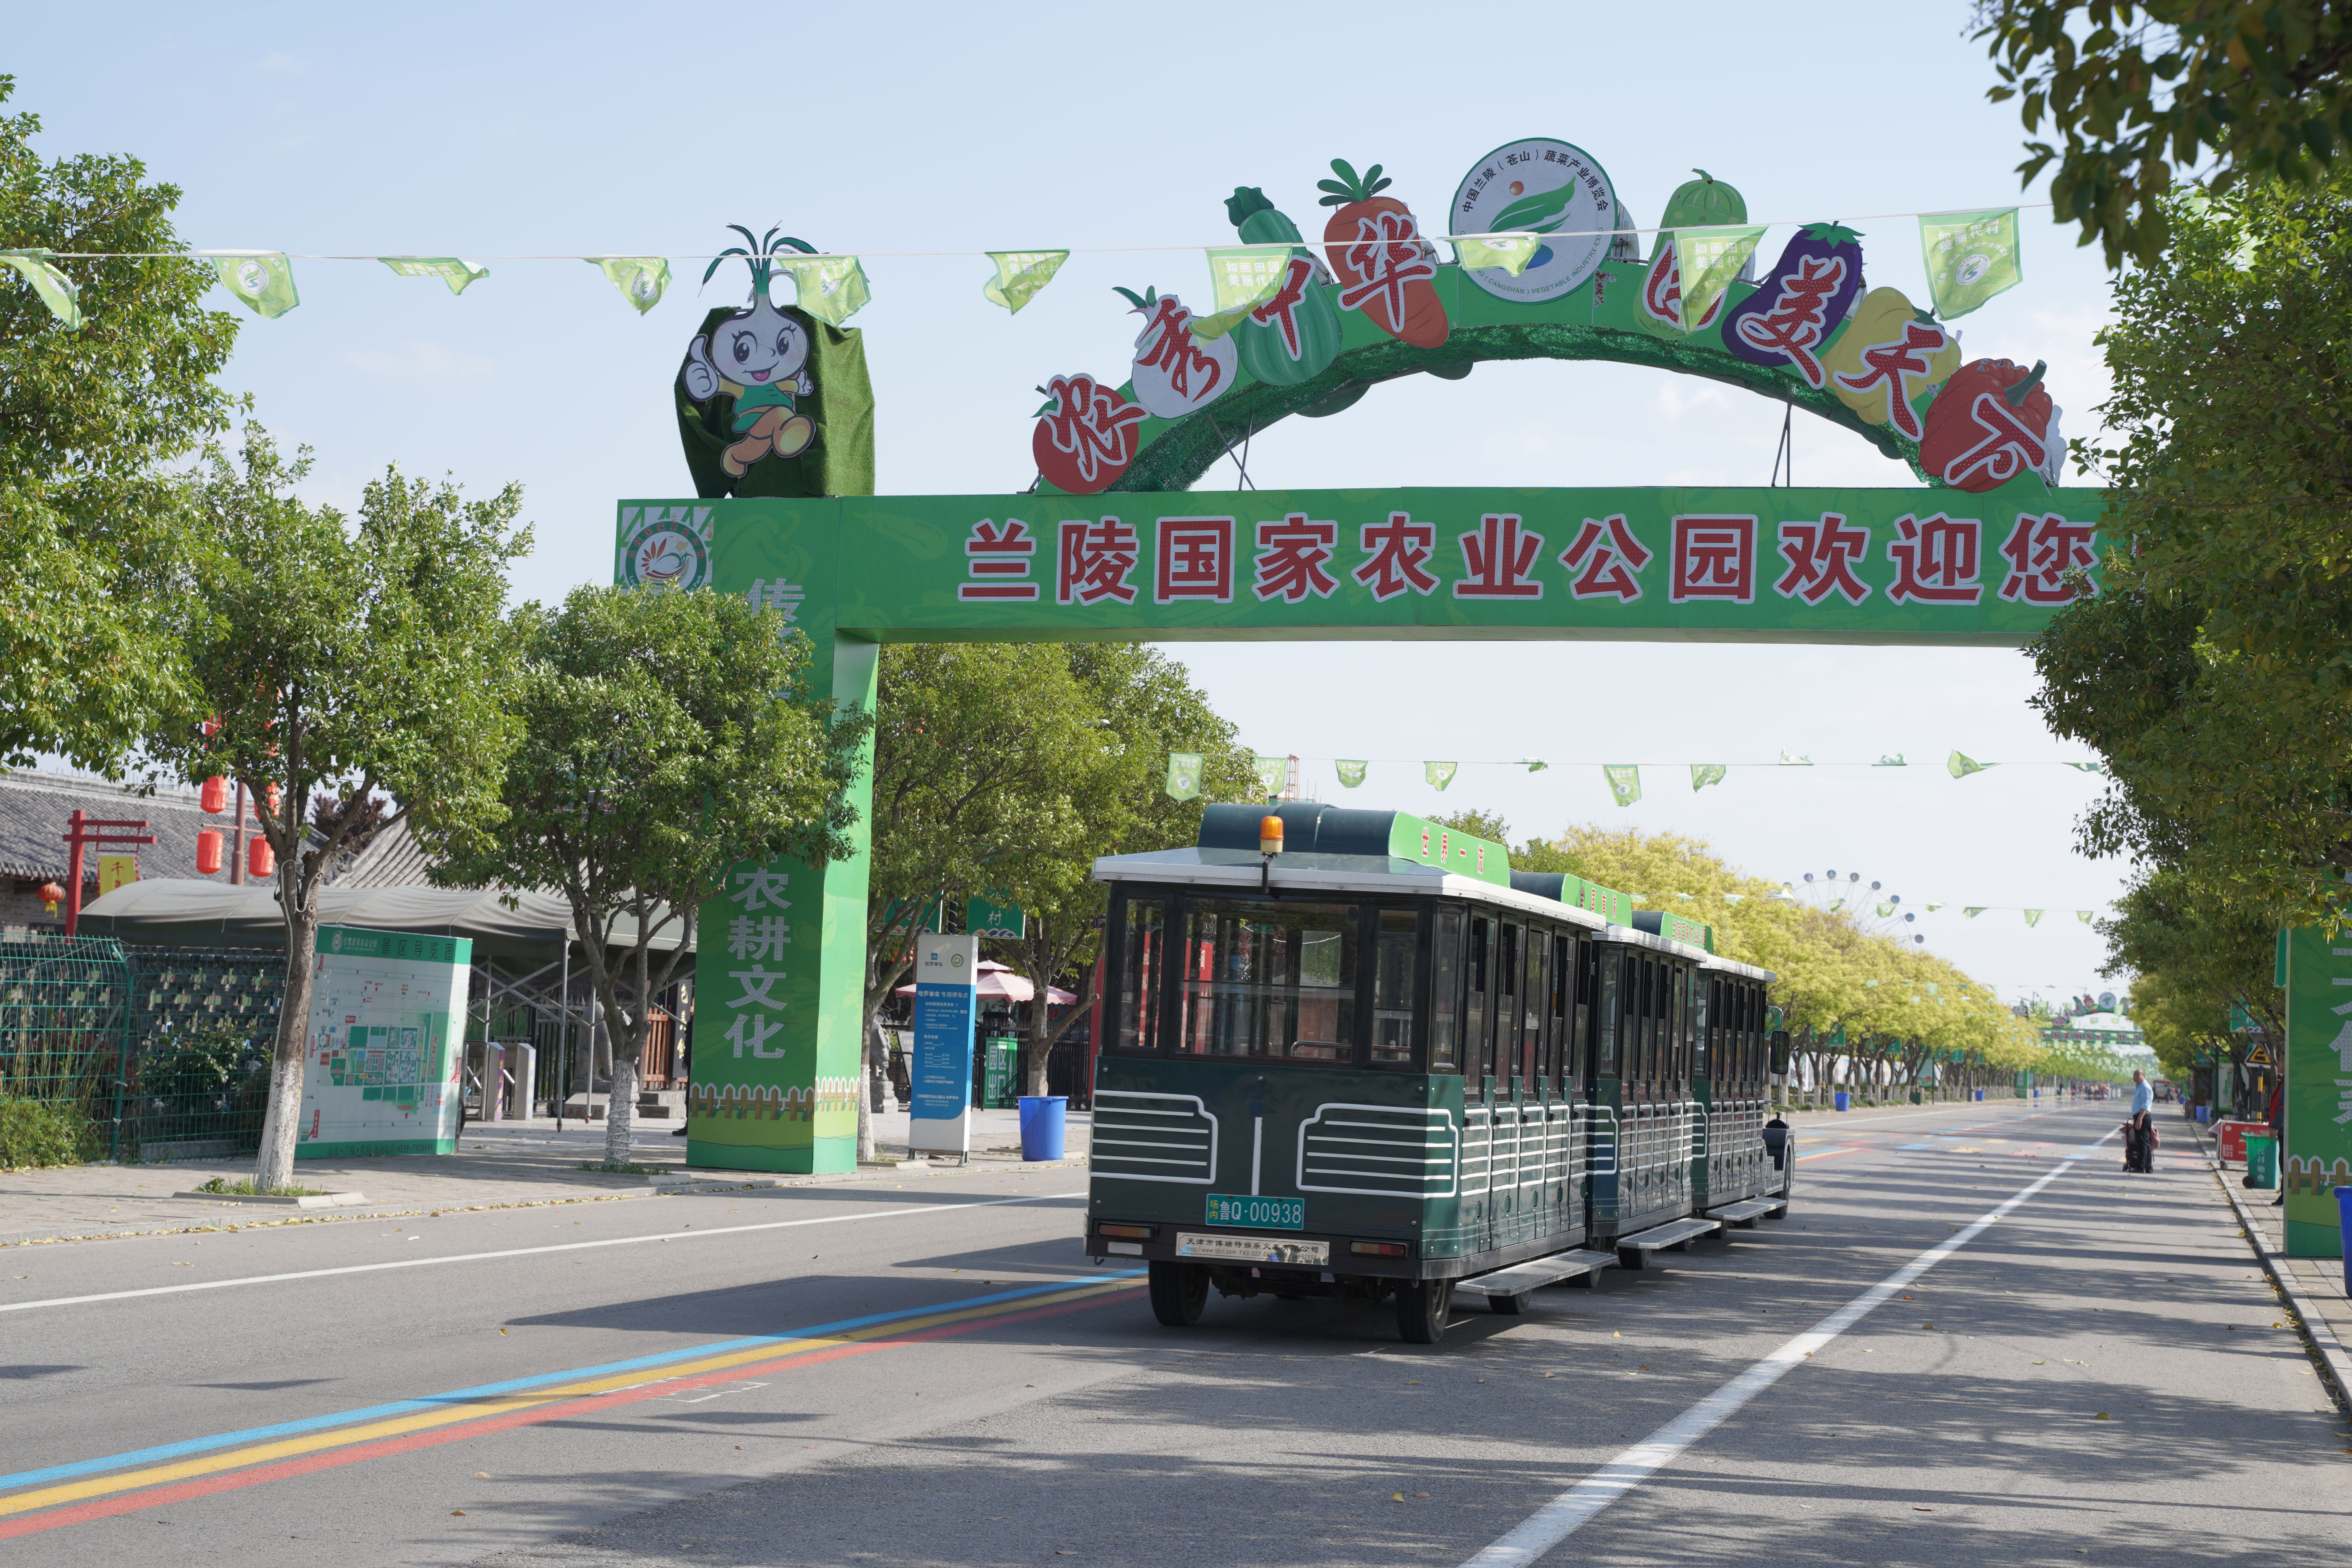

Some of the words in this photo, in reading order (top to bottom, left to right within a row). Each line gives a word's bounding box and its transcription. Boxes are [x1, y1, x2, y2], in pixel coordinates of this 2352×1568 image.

[1006, 253, 1059, 262] 如画田园
[1694, 241, 1754, 255] 如画田园
[1009, 263, 1060, 275] 美丽代村
[1225, 261, 1279, 273] 如画田园
[1532, 276, 1571, 294] VEGETABLE
[1571, 247, 1597, 278] INDUSTRY
[1227, 274, 1279, 287] 美丽代村
[628, 523, 705, 559] 兰陵国家农业公园
[958, 511, 2100, 606] 兰陵国家农业公园欢迎您
[1422, 826, 1483, 874] 世界一流
[381, 938, 454, 960] 景区导览图
[724, 866, 792, 1059] 农耕文化
[429, 1035, 438, 1077] 油菜花海
[989, 1044, 1007, 1071] 园区
[988, 1073, 1006, 1099] 出口
[568, 1107, 601, 1117] 美丽村
[1209, 1200, 1218, 1220] 场内
[1220, 1200, 1301, 1224] 鲁Q·00938
[1186, 1238, 1319, 1253] 天津市博瑞特娱乐火车有限公司
